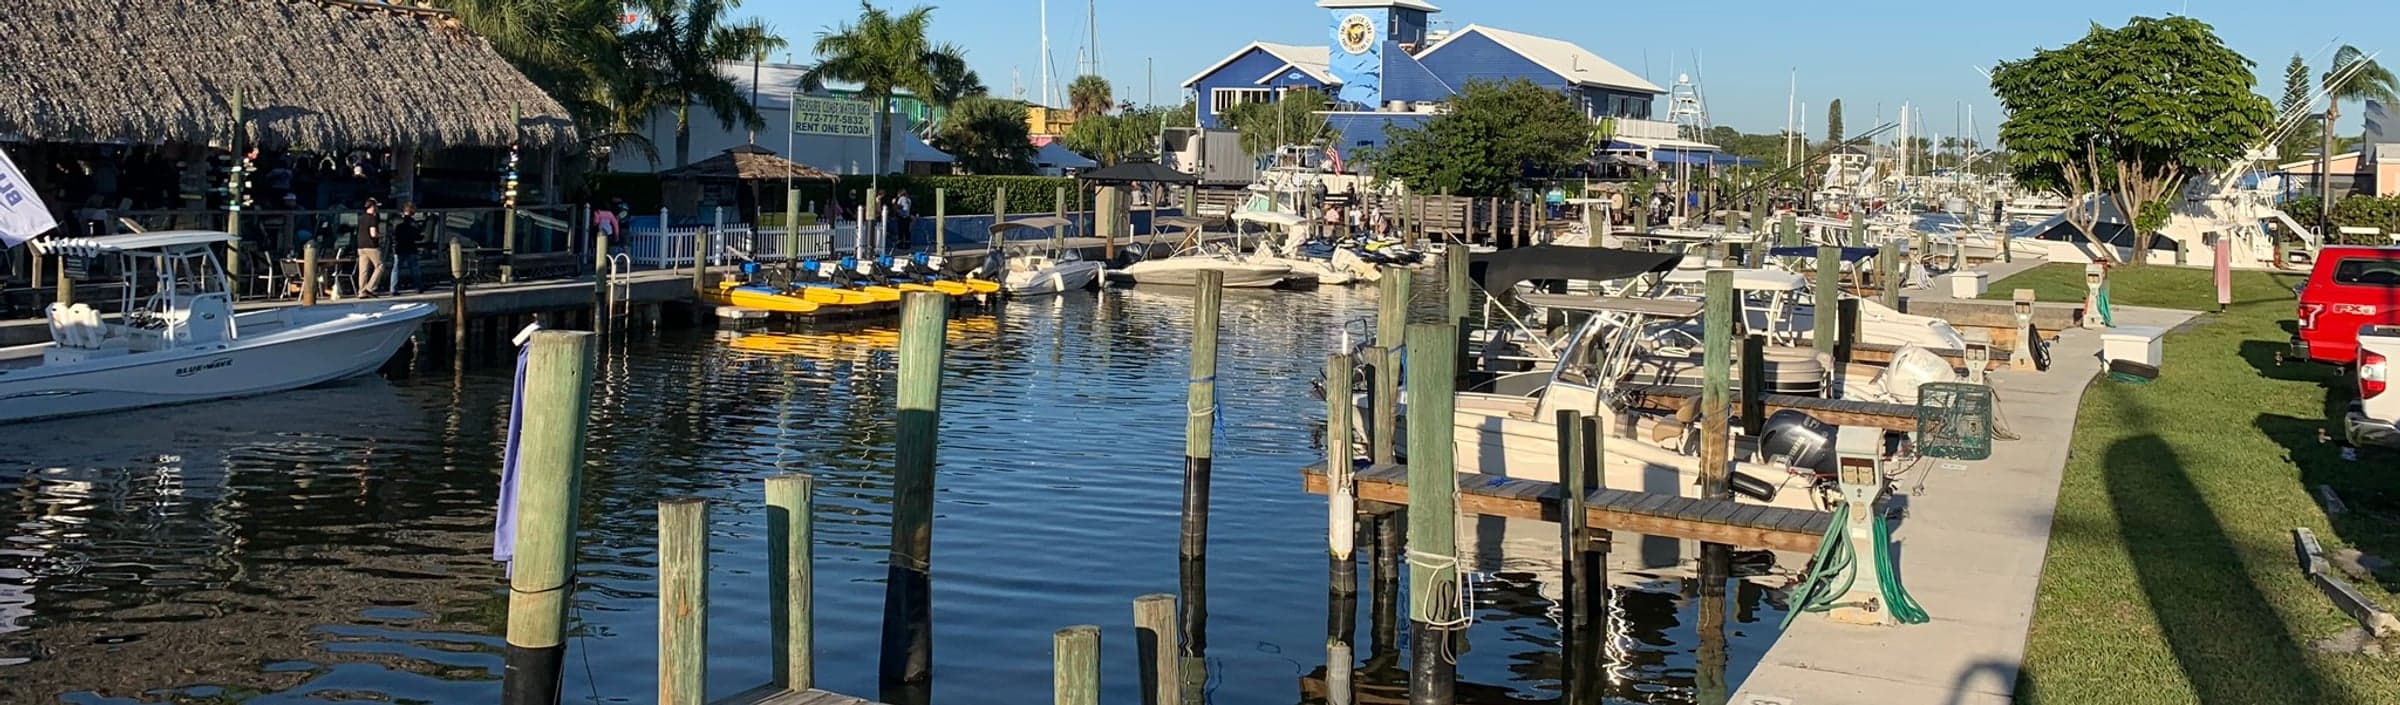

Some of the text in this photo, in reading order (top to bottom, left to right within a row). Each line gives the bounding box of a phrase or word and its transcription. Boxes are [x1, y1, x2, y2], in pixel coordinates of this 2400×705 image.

[803, 113, 864, 125] 772-777-5832
[796, 122, 870, 135] RENT ONE TODAY
